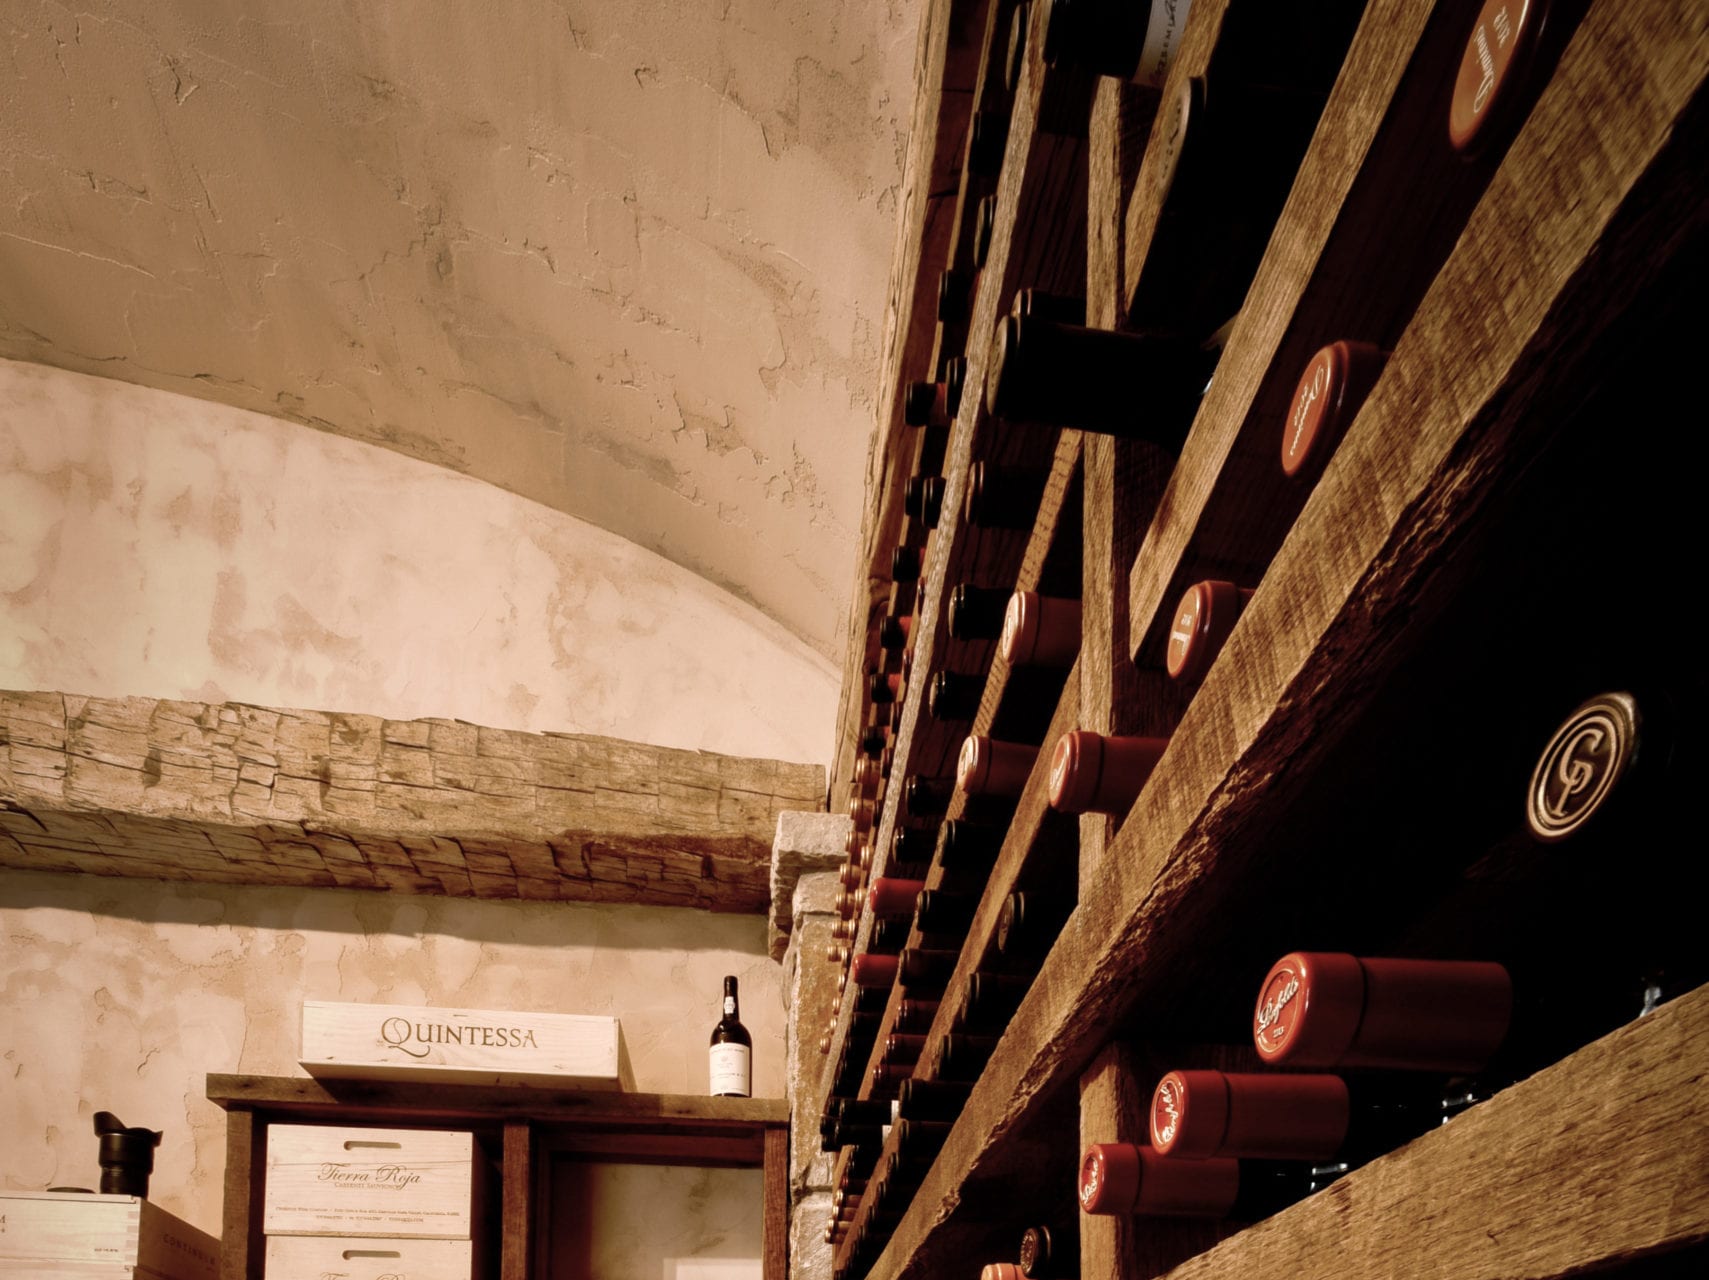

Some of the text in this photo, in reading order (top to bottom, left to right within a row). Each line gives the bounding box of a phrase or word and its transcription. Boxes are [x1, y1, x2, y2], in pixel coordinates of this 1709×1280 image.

[1473, 24, 1495, 114] Dominus
[381, 1016, 539, 1058] QUINTESSA
[317, 1161, 421, 1191] Tierra Roja
